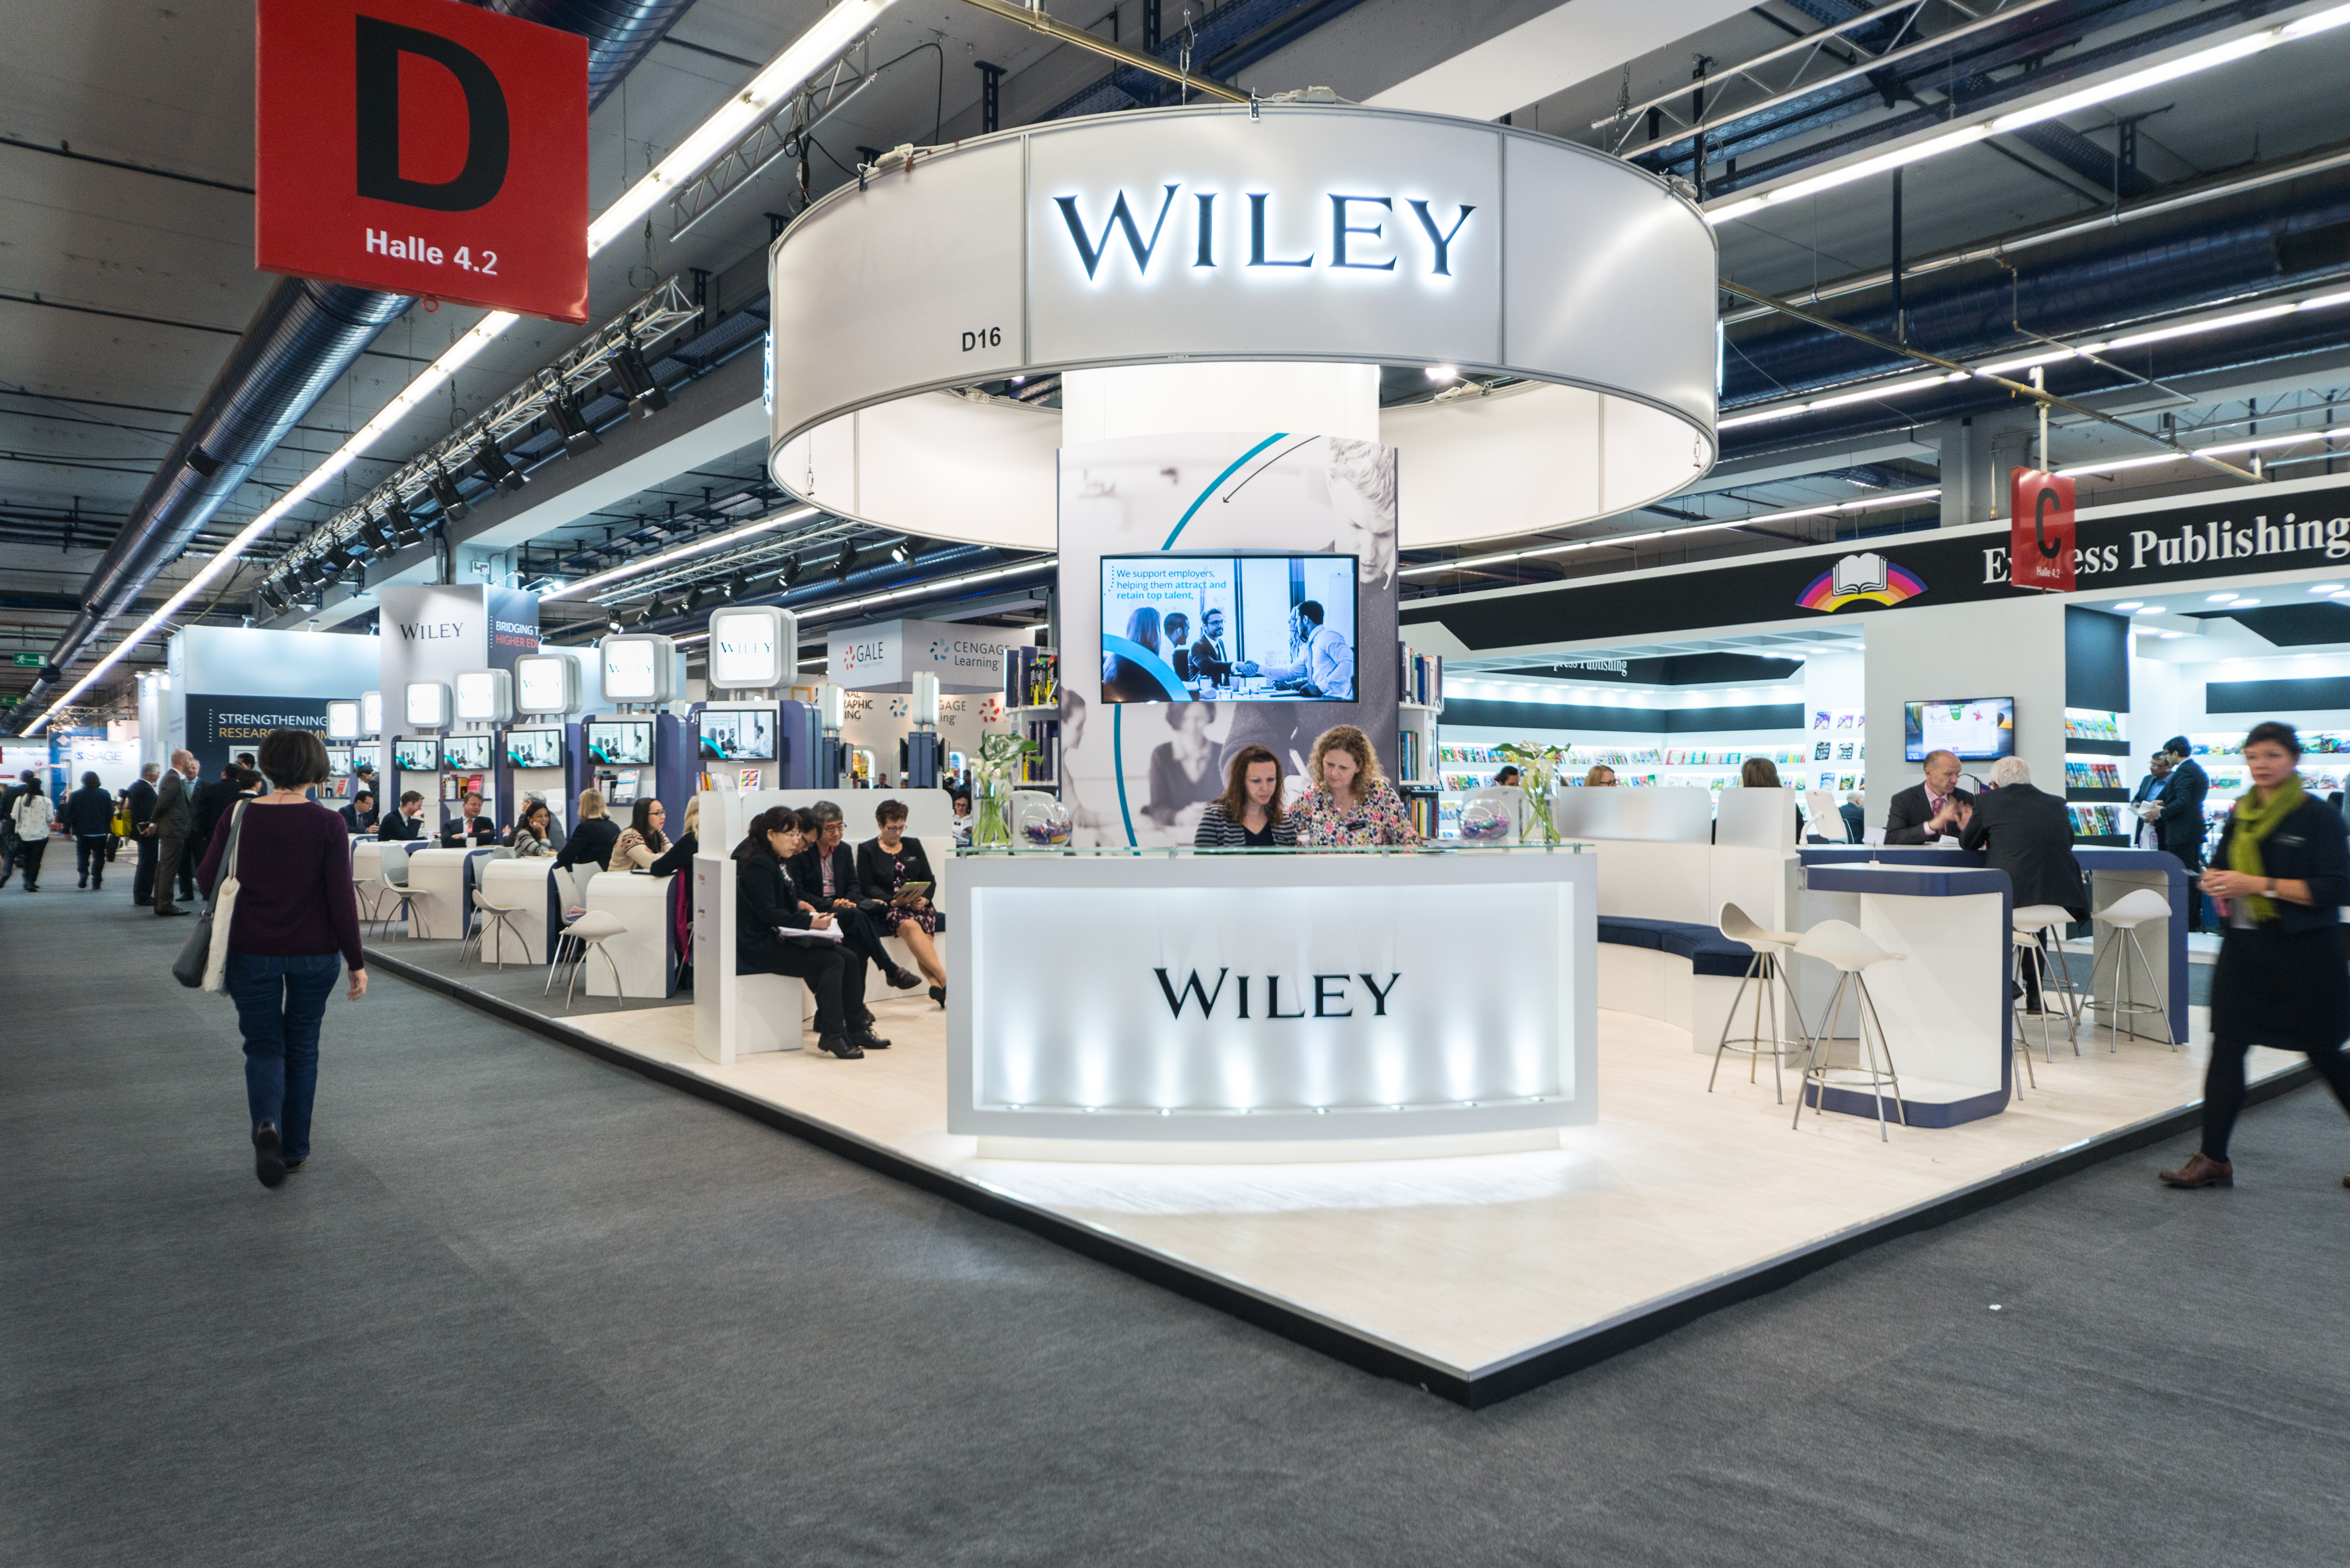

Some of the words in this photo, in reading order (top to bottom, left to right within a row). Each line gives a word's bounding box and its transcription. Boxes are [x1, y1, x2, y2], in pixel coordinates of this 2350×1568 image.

[356, 14, 510, 211] D
[1052, 183, 1477, 282] WILEY
[366, 228, 443, 265] Halle
[453, 246, 498, 275] 4.2
[962, 327, 1002, 352] D16
[2036, 488, 2061, 559] C
[2130, 513, 2350, 569] Publishing
[1133, 571, 1166, 579] support
[1168, 570, 1215, 579] employers,
[2037, 566, 2051, 577] Halle
[2051, 568, 2060, 578] 4.2
[1117, 581, 1148, 591] helping
[1147, 592, 1162, 601] top
[1165, 592, 1194, 600] talent,
[400, 622, 463, 640] WILEY
[496, 621, 533, 635] BRIDGING
[496, 634, 525, 647] HIGHER
[857, 642, 883, 662] GALE
[219, 714, 327, 726] STRENGTHENING
[86, 751, 122, 761] SAGE
[1153, 967, 1402, 1020] WILEY
